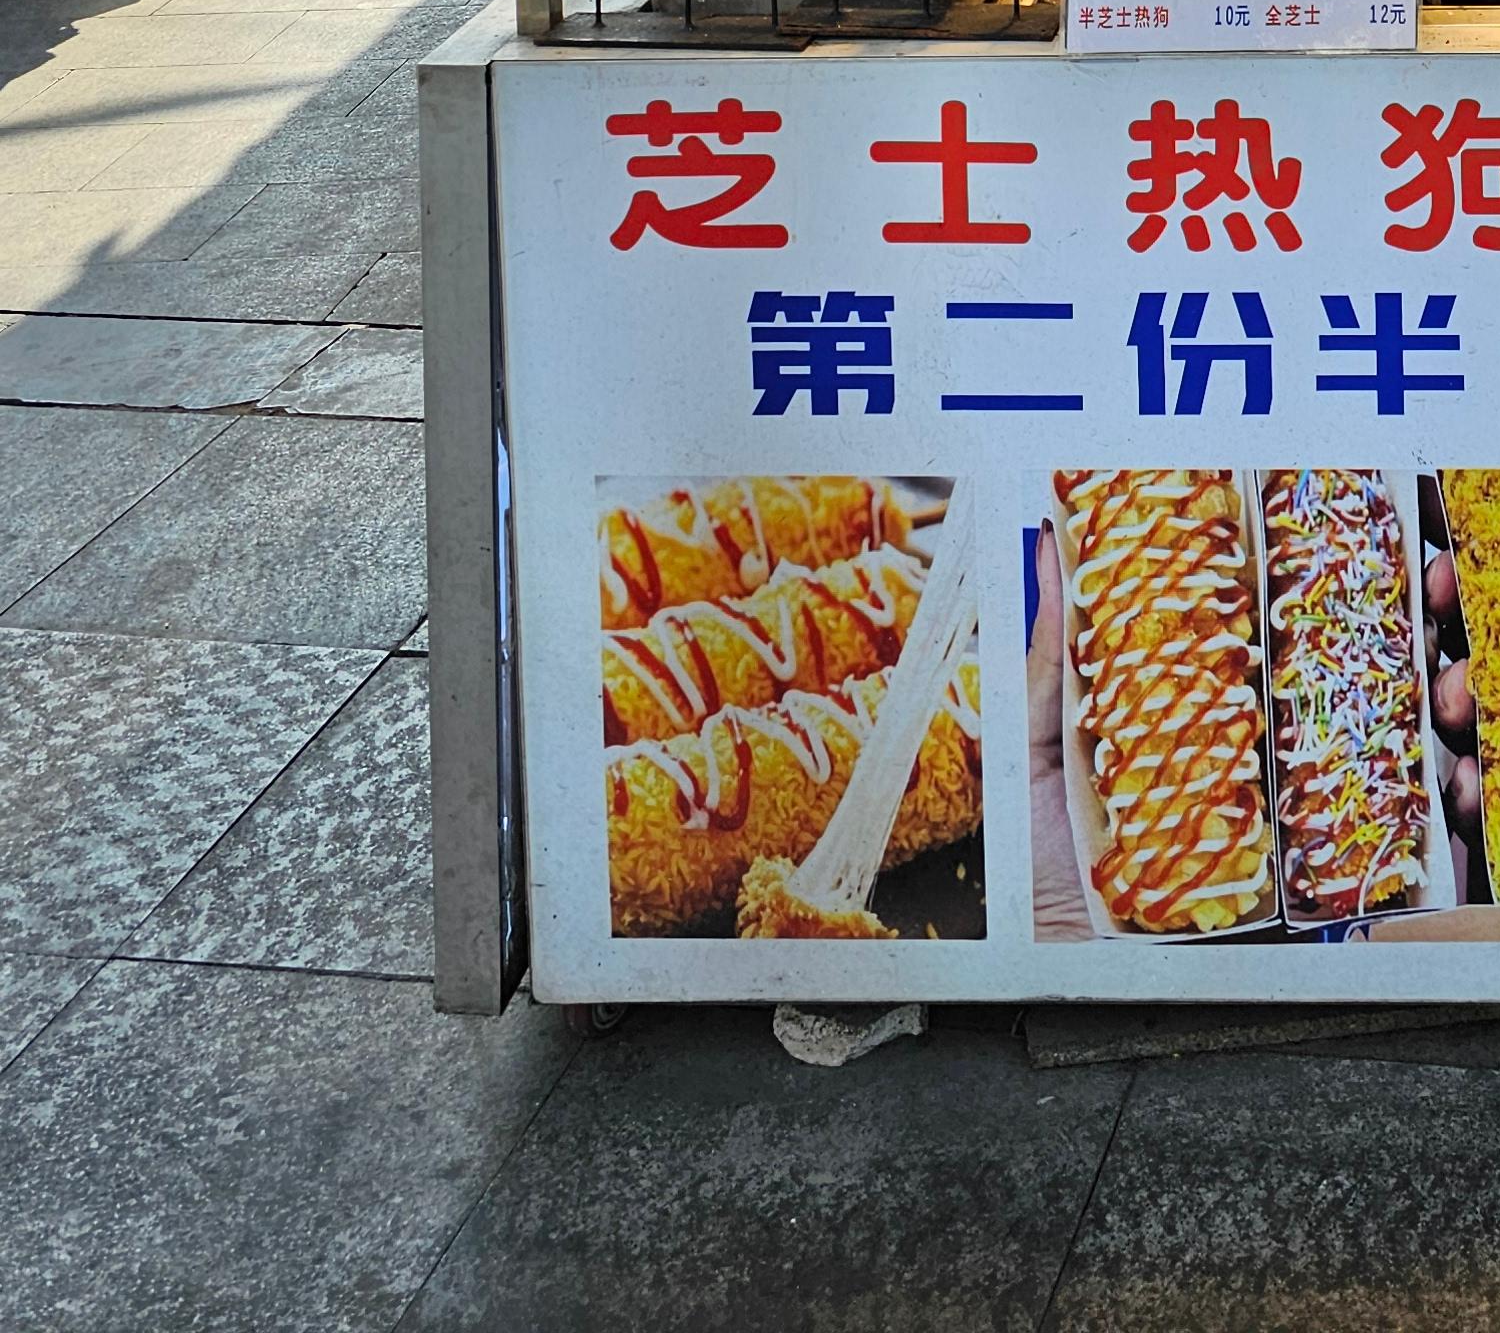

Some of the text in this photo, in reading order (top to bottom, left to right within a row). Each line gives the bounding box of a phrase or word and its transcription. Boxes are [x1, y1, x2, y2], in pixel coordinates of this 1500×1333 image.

[1078, 4, 1406, 29] 半芝士热狗 10元 全芝士 12元
